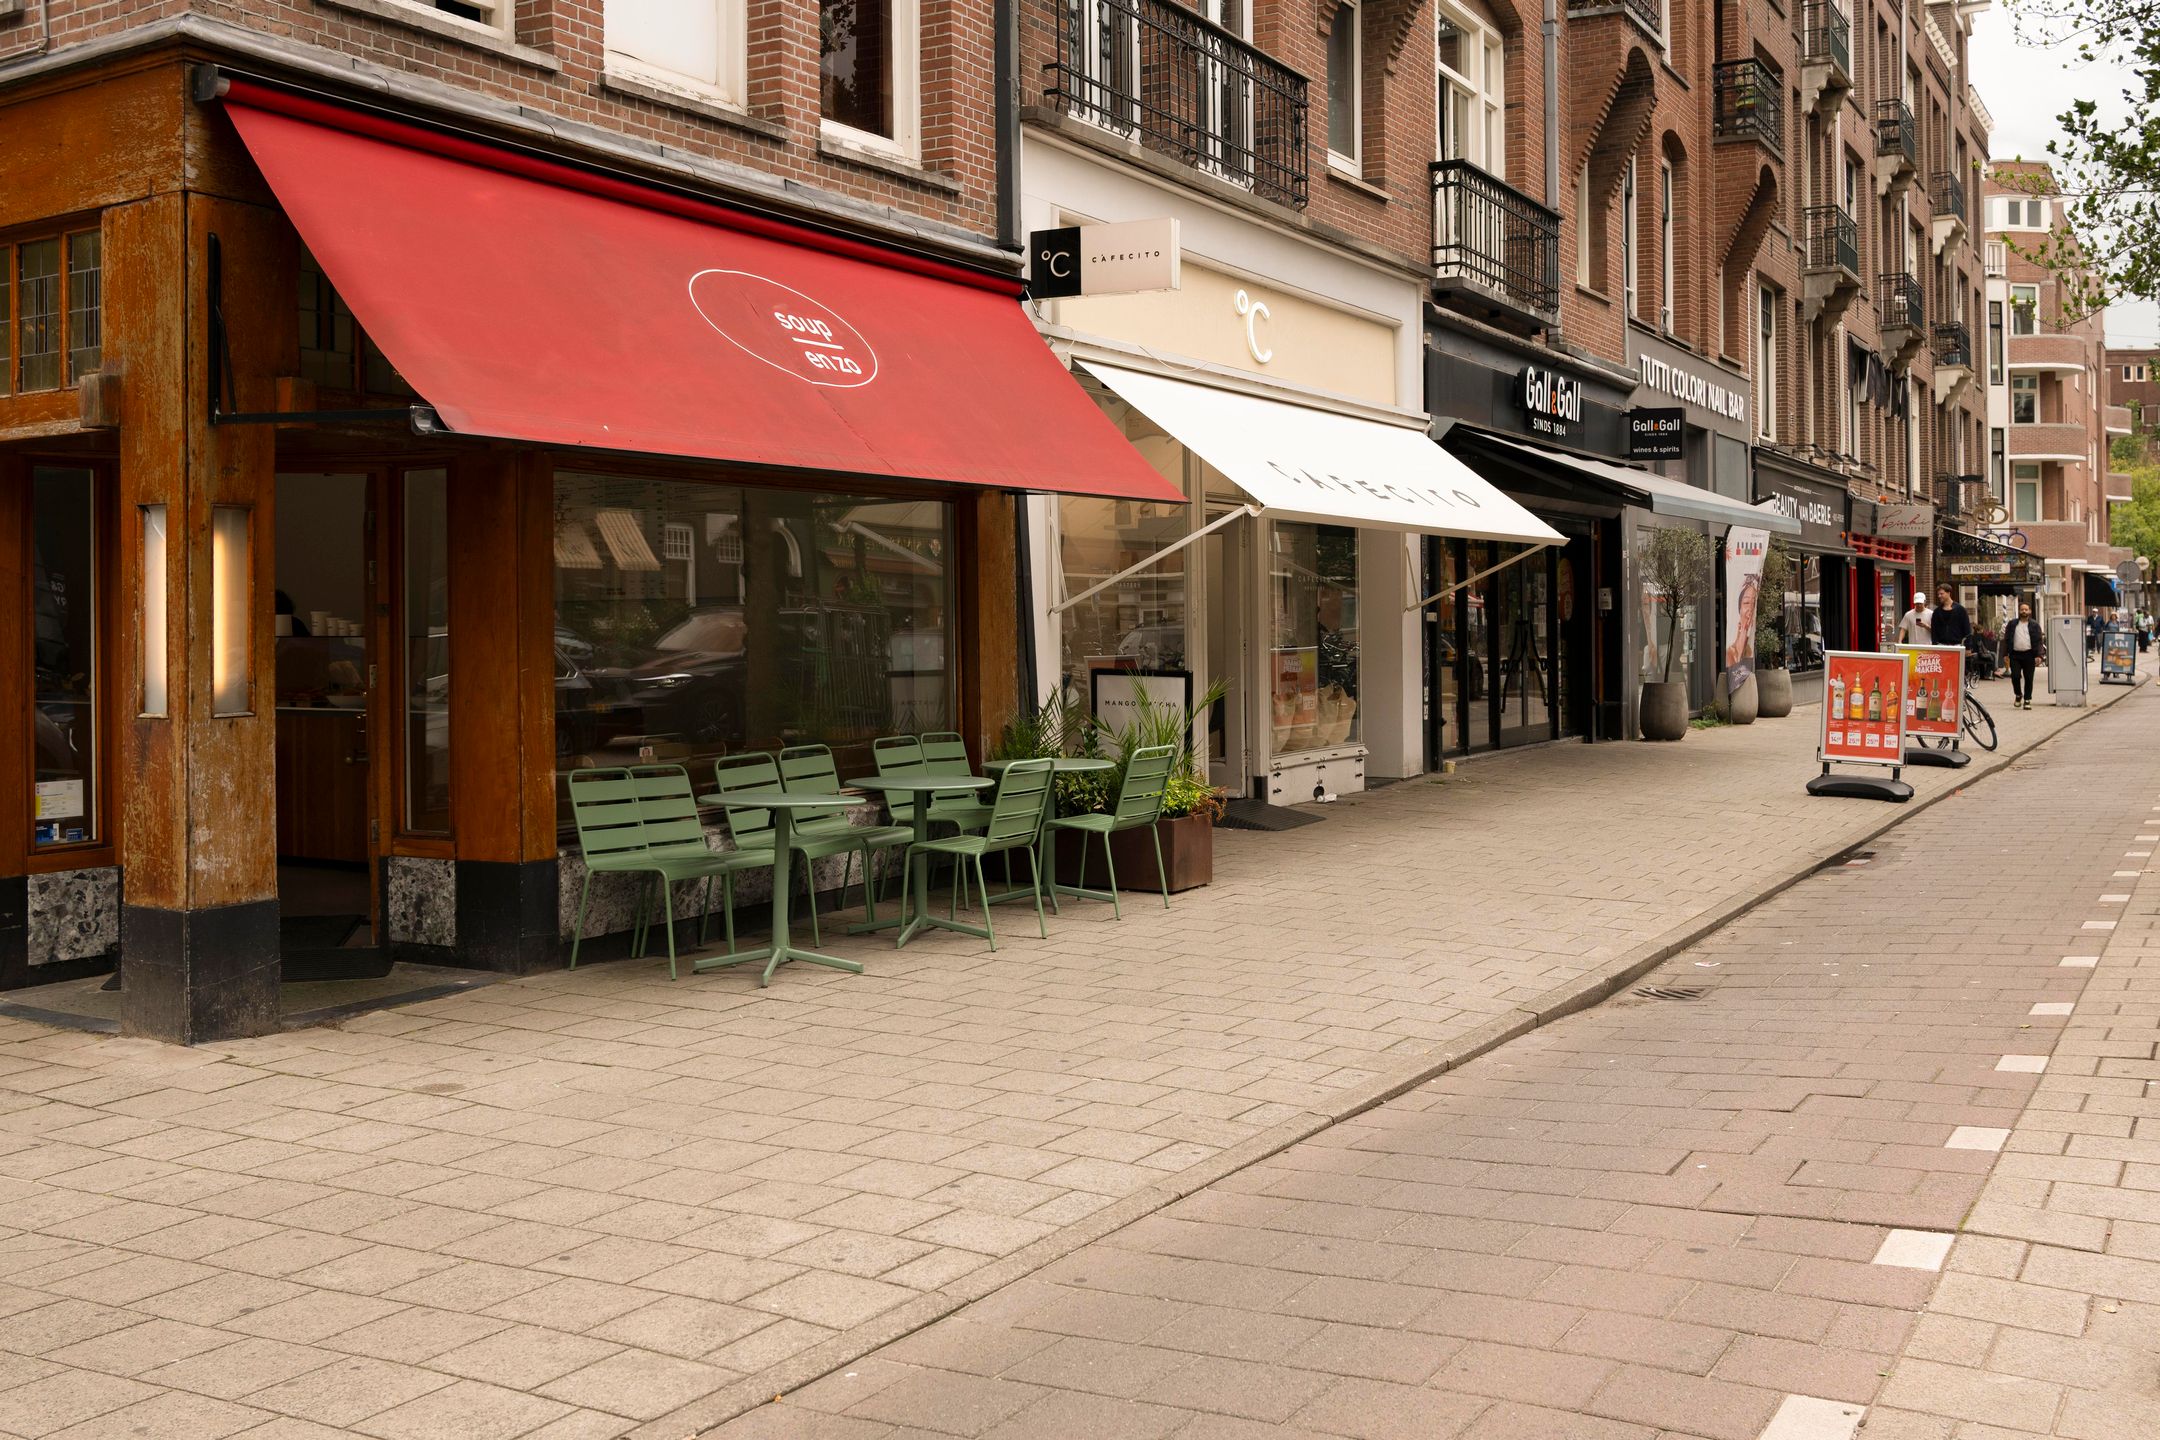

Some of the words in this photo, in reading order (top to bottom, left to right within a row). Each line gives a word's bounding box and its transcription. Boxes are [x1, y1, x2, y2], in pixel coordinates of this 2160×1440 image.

[774, 311, 833, 342] soup
[1640, 353, 1670, 393] TUTTI
[1671, 367, 1706, 407] COLORI
[1707, 382, 1728, 416] NAIL
[1728, 391, 1745, 422] BAR
[1533, 417, 1552, 433] SINDS
[1553, 422, 1567, 437] 1884
[1659, 445, 1680, 454] spirits
[1809, 501, 1832, 526] BAERLE
[1958, 564, 2003, 573] PATISSERIE
